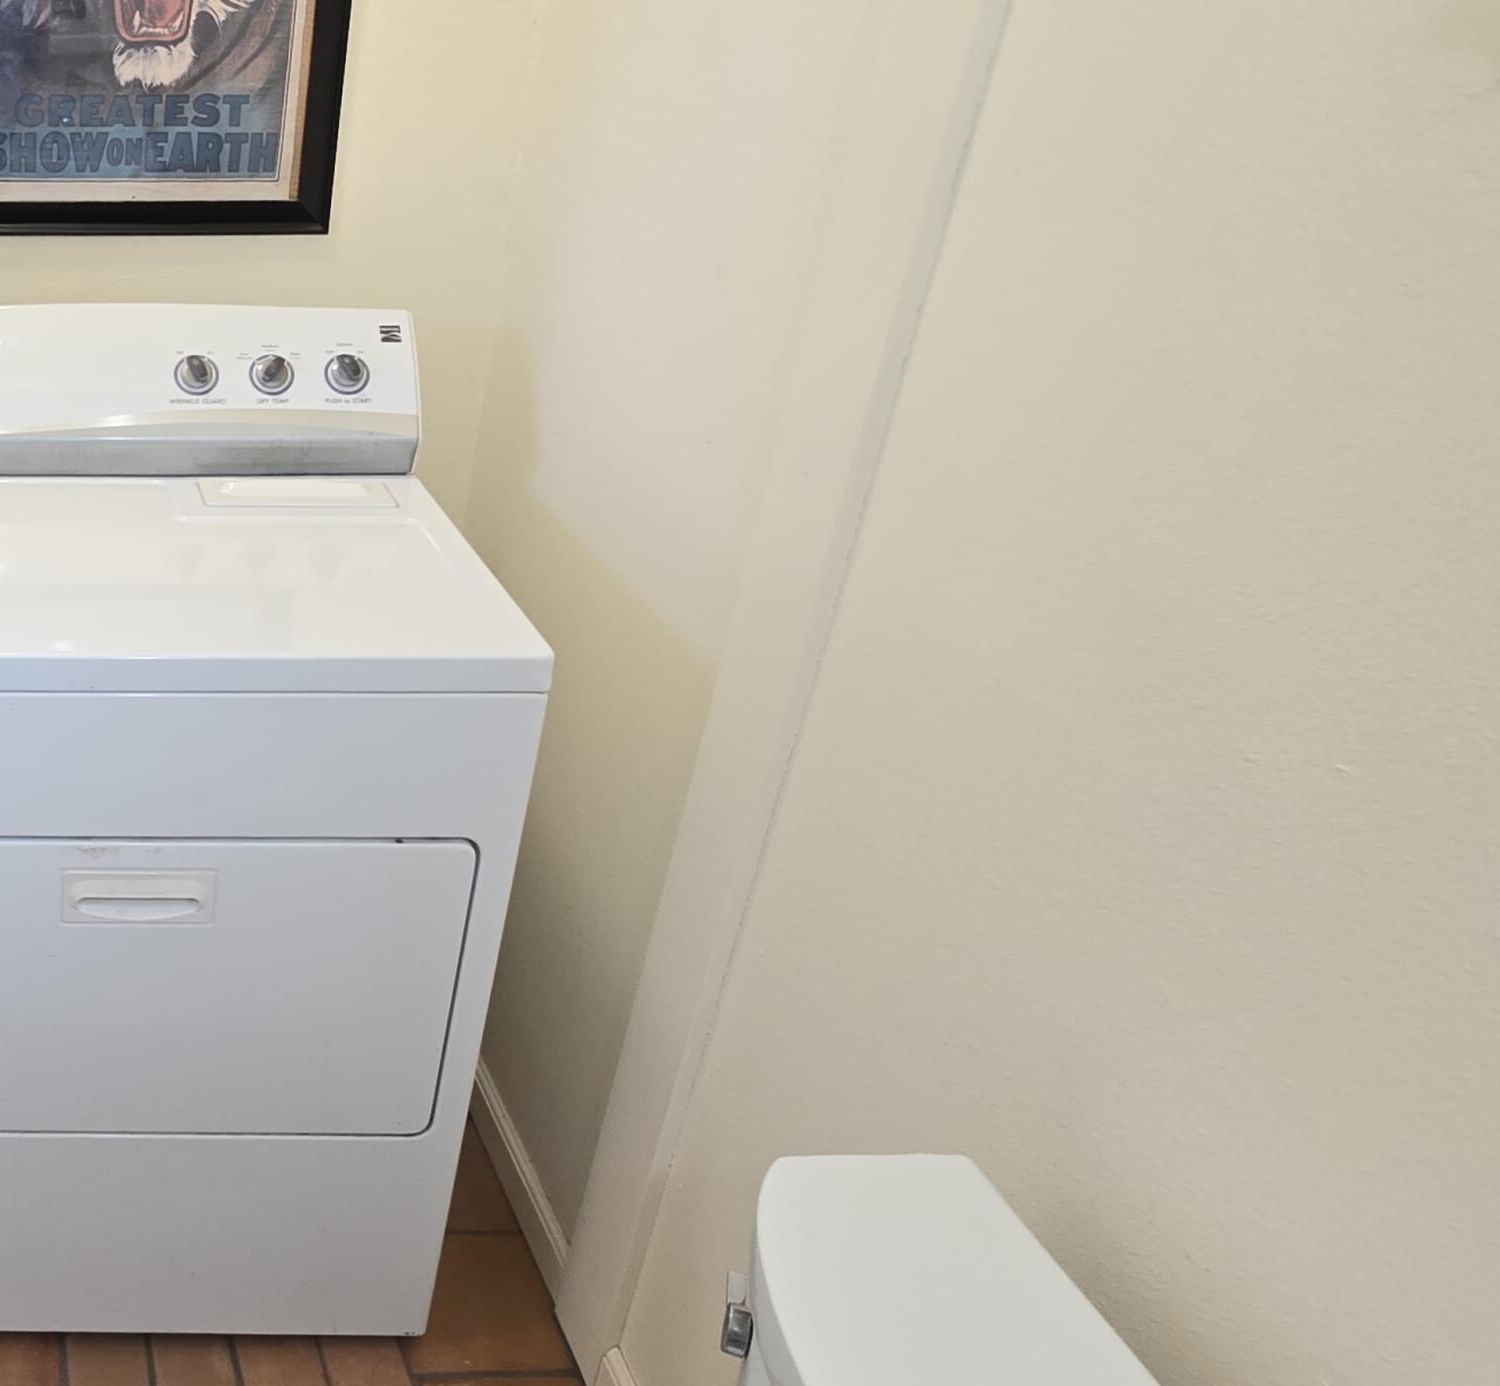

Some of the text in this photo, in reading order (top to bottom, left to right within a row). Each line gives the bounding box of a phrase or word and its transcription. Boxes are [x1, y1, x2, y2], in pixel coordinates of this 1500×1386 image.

[13, 92, 252, 128] GREATEST
[109, 136, 143, 168] ON
[143, 131, 279, 174] EARTH
